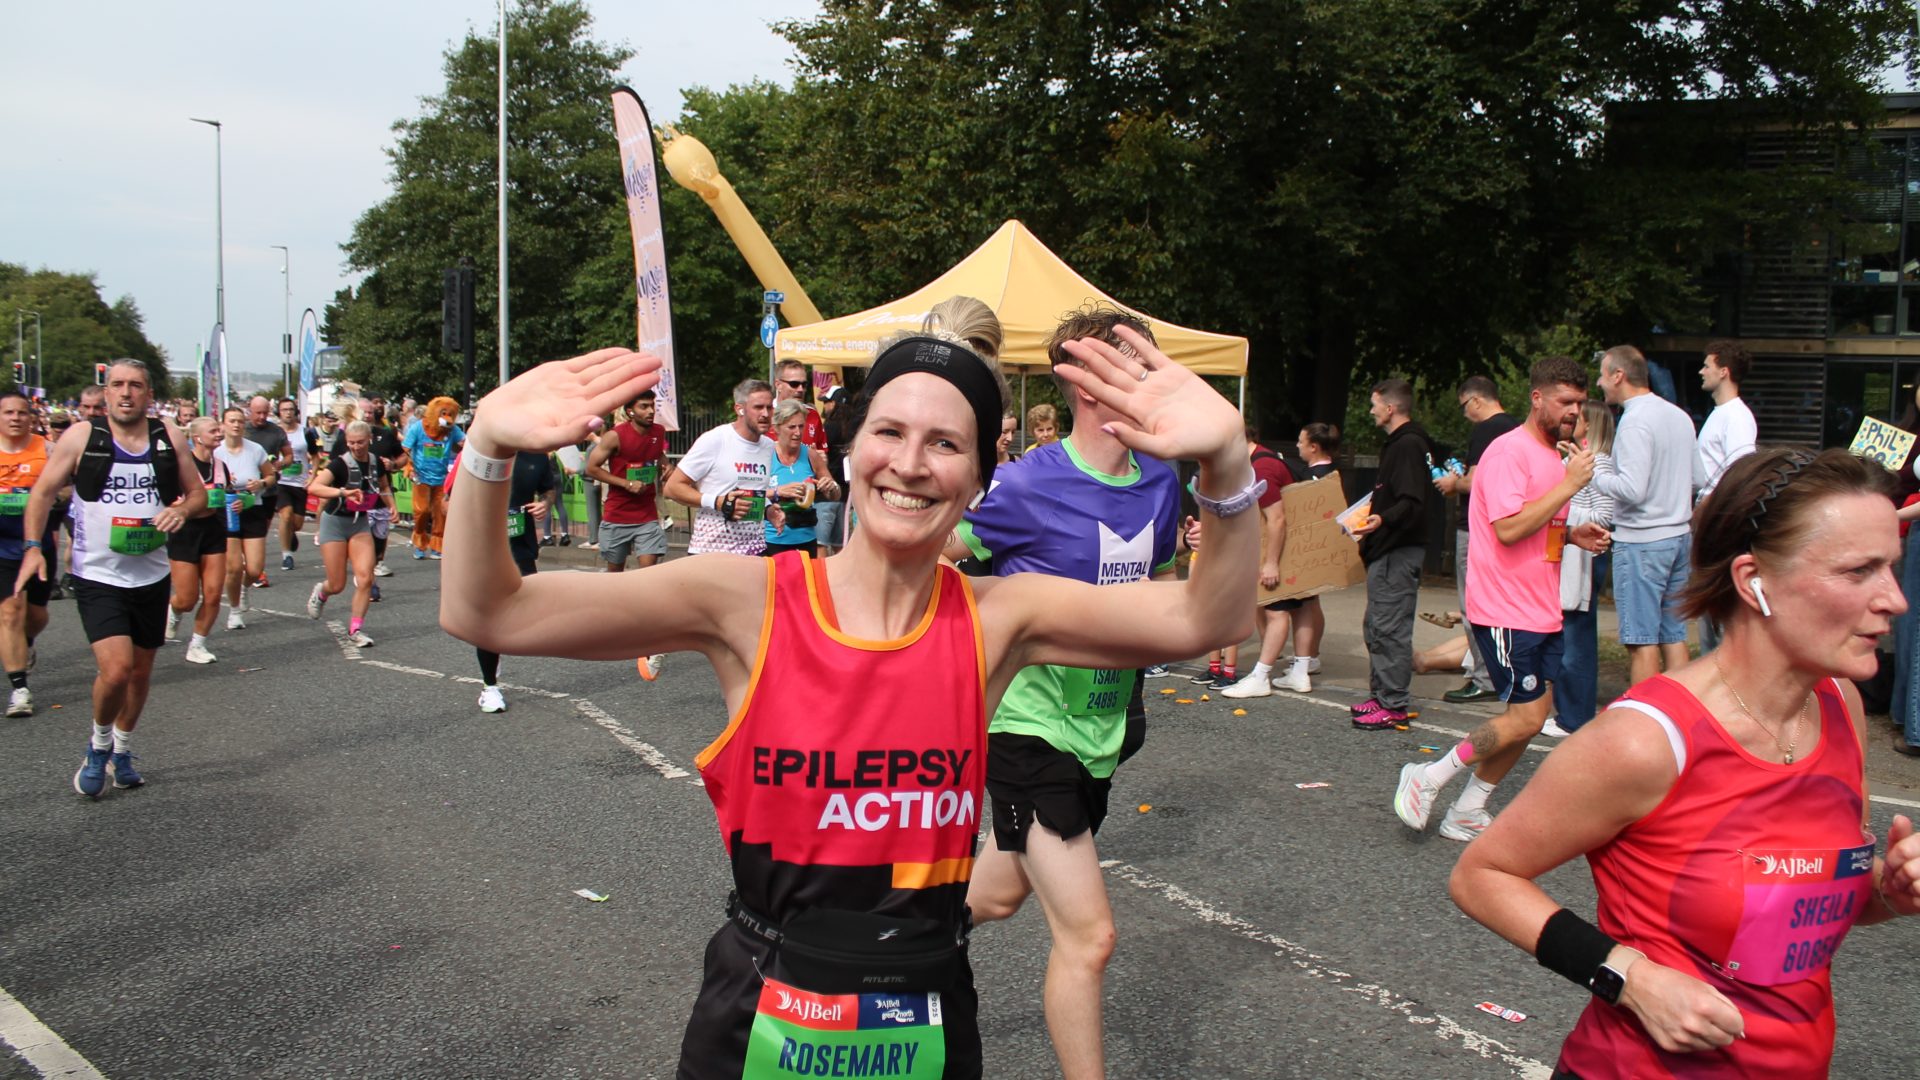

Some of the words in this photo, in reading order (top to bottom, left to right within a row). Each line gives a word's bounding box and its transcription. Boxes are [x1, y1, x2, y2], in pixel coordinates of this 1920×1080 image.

[914, 355, 948, 366] RUN
[735, 462, 766, 475] YMCA
[100, 486, 160, 506] ociety
[1101, 561, 1147, 577] MENTAL
[1093, 669, 1121, 685] ISAAC
[754, 747, 973, 788] EPILEPSY
[817, 790, 974, 832] ACTION
[1775, 857, 1823, 878] AJBell
[1790, 890, 1856, 929] SHEILA
[789, 999, 842, 1021] AJBell
[778, 1036, 919, 1078] ROSEMARY
